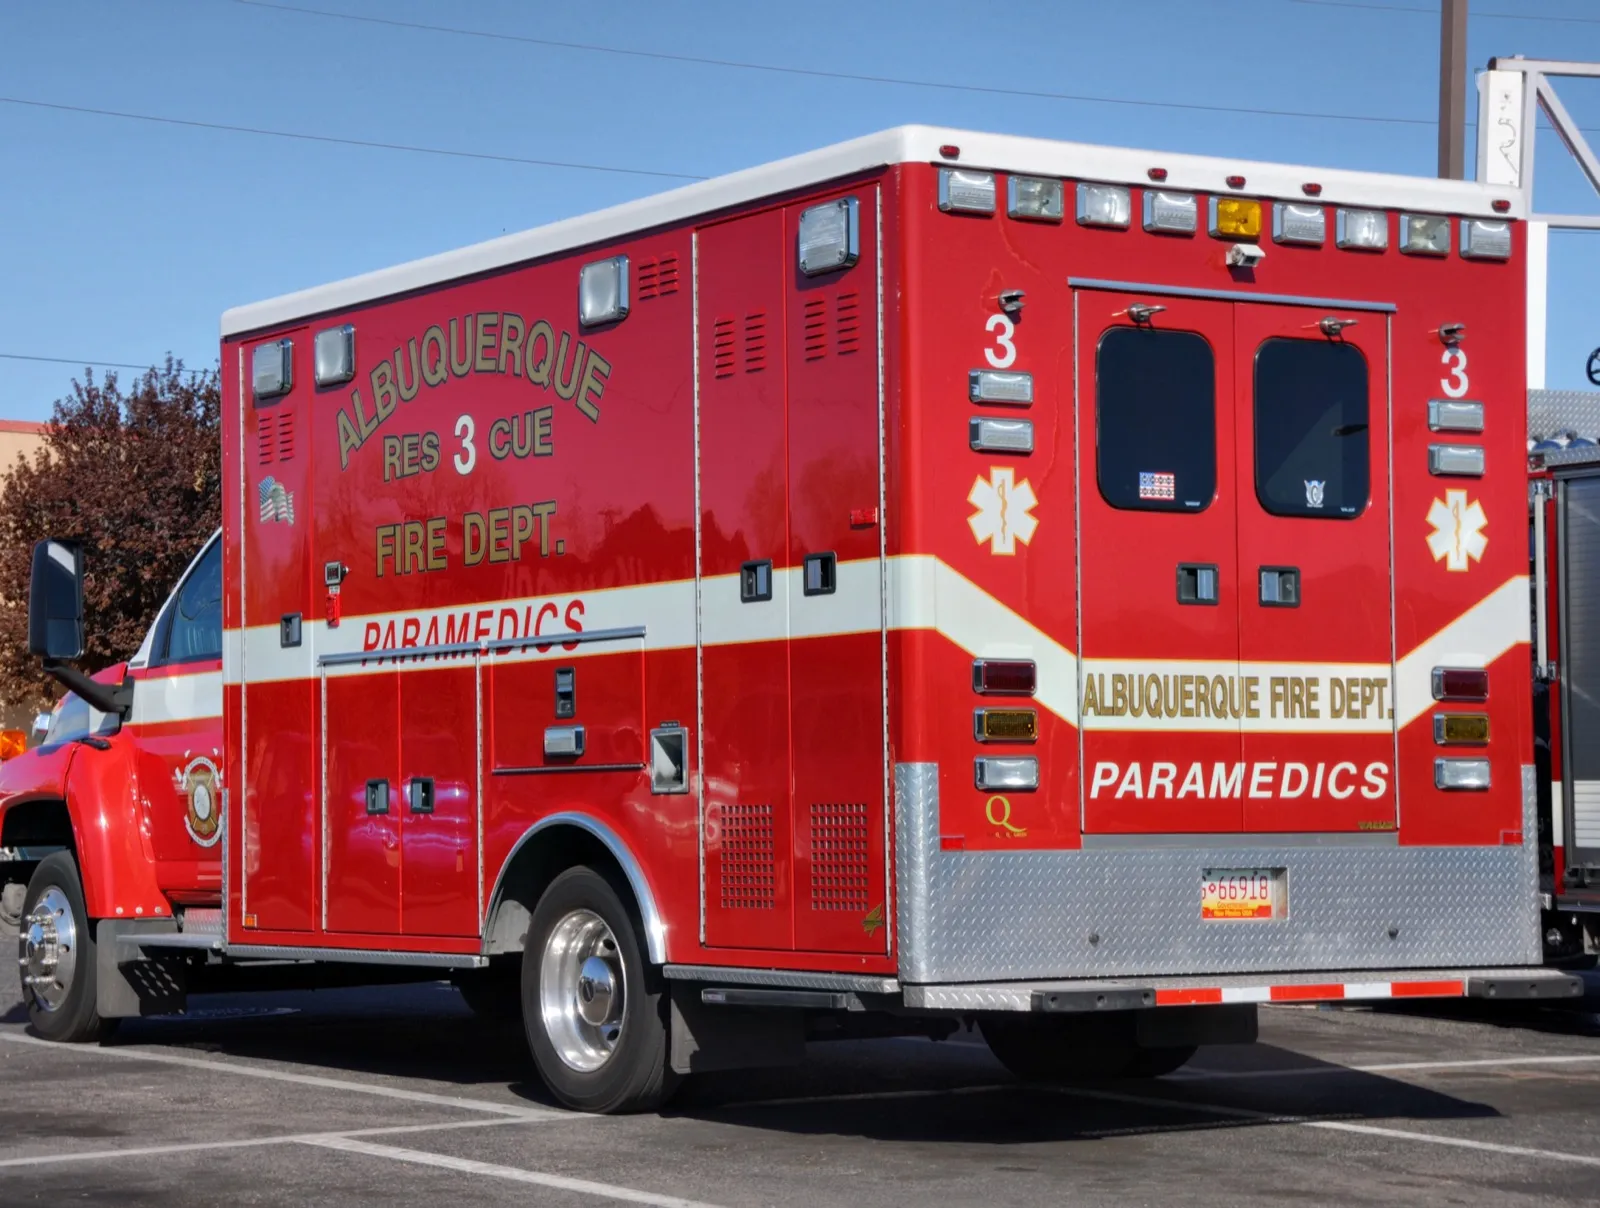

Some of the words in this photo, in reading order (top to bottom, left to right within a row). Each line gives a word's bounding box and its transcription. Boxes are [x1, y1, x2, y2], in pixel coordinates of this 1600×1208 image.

[984, 314, 1017, 369] 3
[335, 312, 611, 472] ALBUQUERQUE
[1440, 348, 1469, 398] 3
[383, 431, 440, 482] RES
[453, 414, 476, 475] 3
[488, 406, 553, 460] CUE
[375, 516, 447, 577] FIRE
[463, 500, 565, 566] DEPT.
[361, 599, 585, 667] PARAMEDICS
[1082, 673, 1260, 720] ALBUQUERQUE
[1270, 676, 1320, 719] FIRE
[1330, 677, 1394, 719] DEPT.
[1089, 761, 1389, 800] PARAMEDICS
[985, 795, 1027, 833] Q
